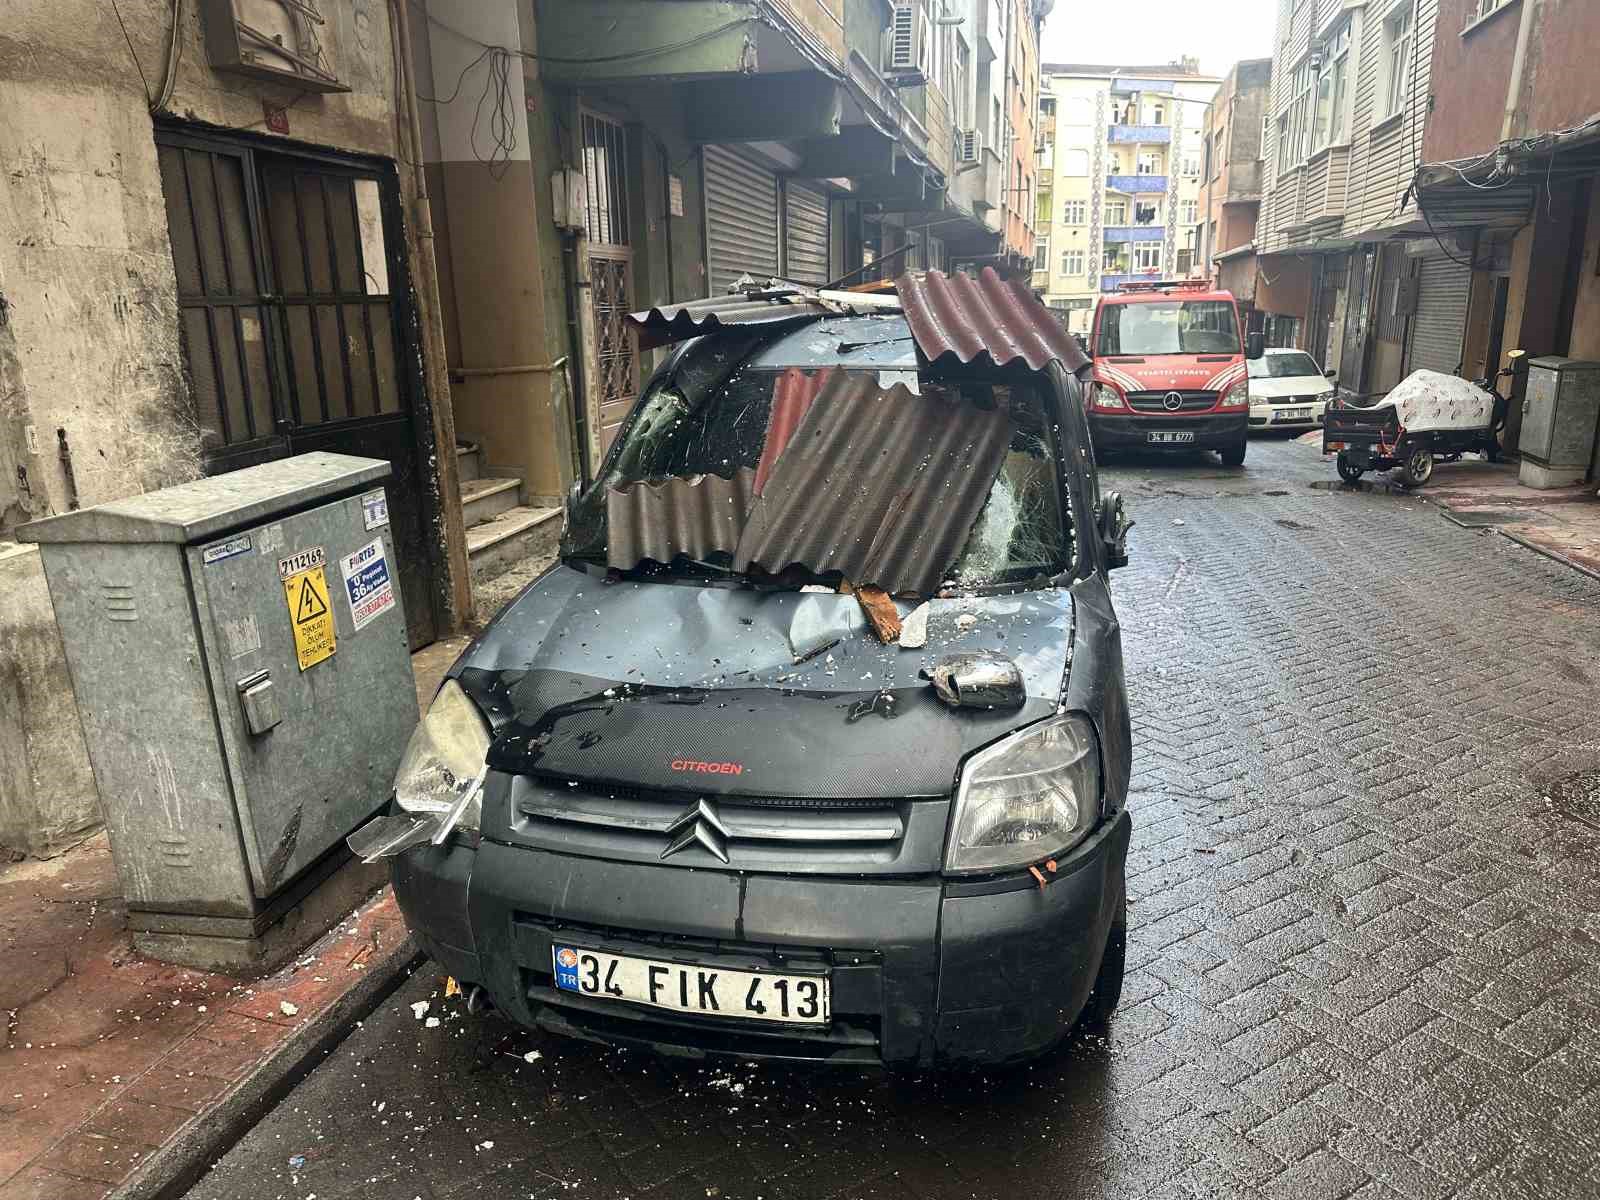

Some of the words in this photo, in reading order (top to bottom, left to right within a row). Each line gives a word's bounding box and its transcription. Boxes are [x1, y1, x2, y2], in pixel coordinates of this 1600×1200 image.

[1151, 433, 1161, 441] 34
[1175, 433, 1193, 441] 6777
[281, 549, 322, 575] 7112169
[353, 583, 367, 601] 36
[559, 973, 577, 986] TR
[580, 954, 624, 997] 34
[648, 965, 720, 1011] FIK
[745, 977, 819, 1019] 413
